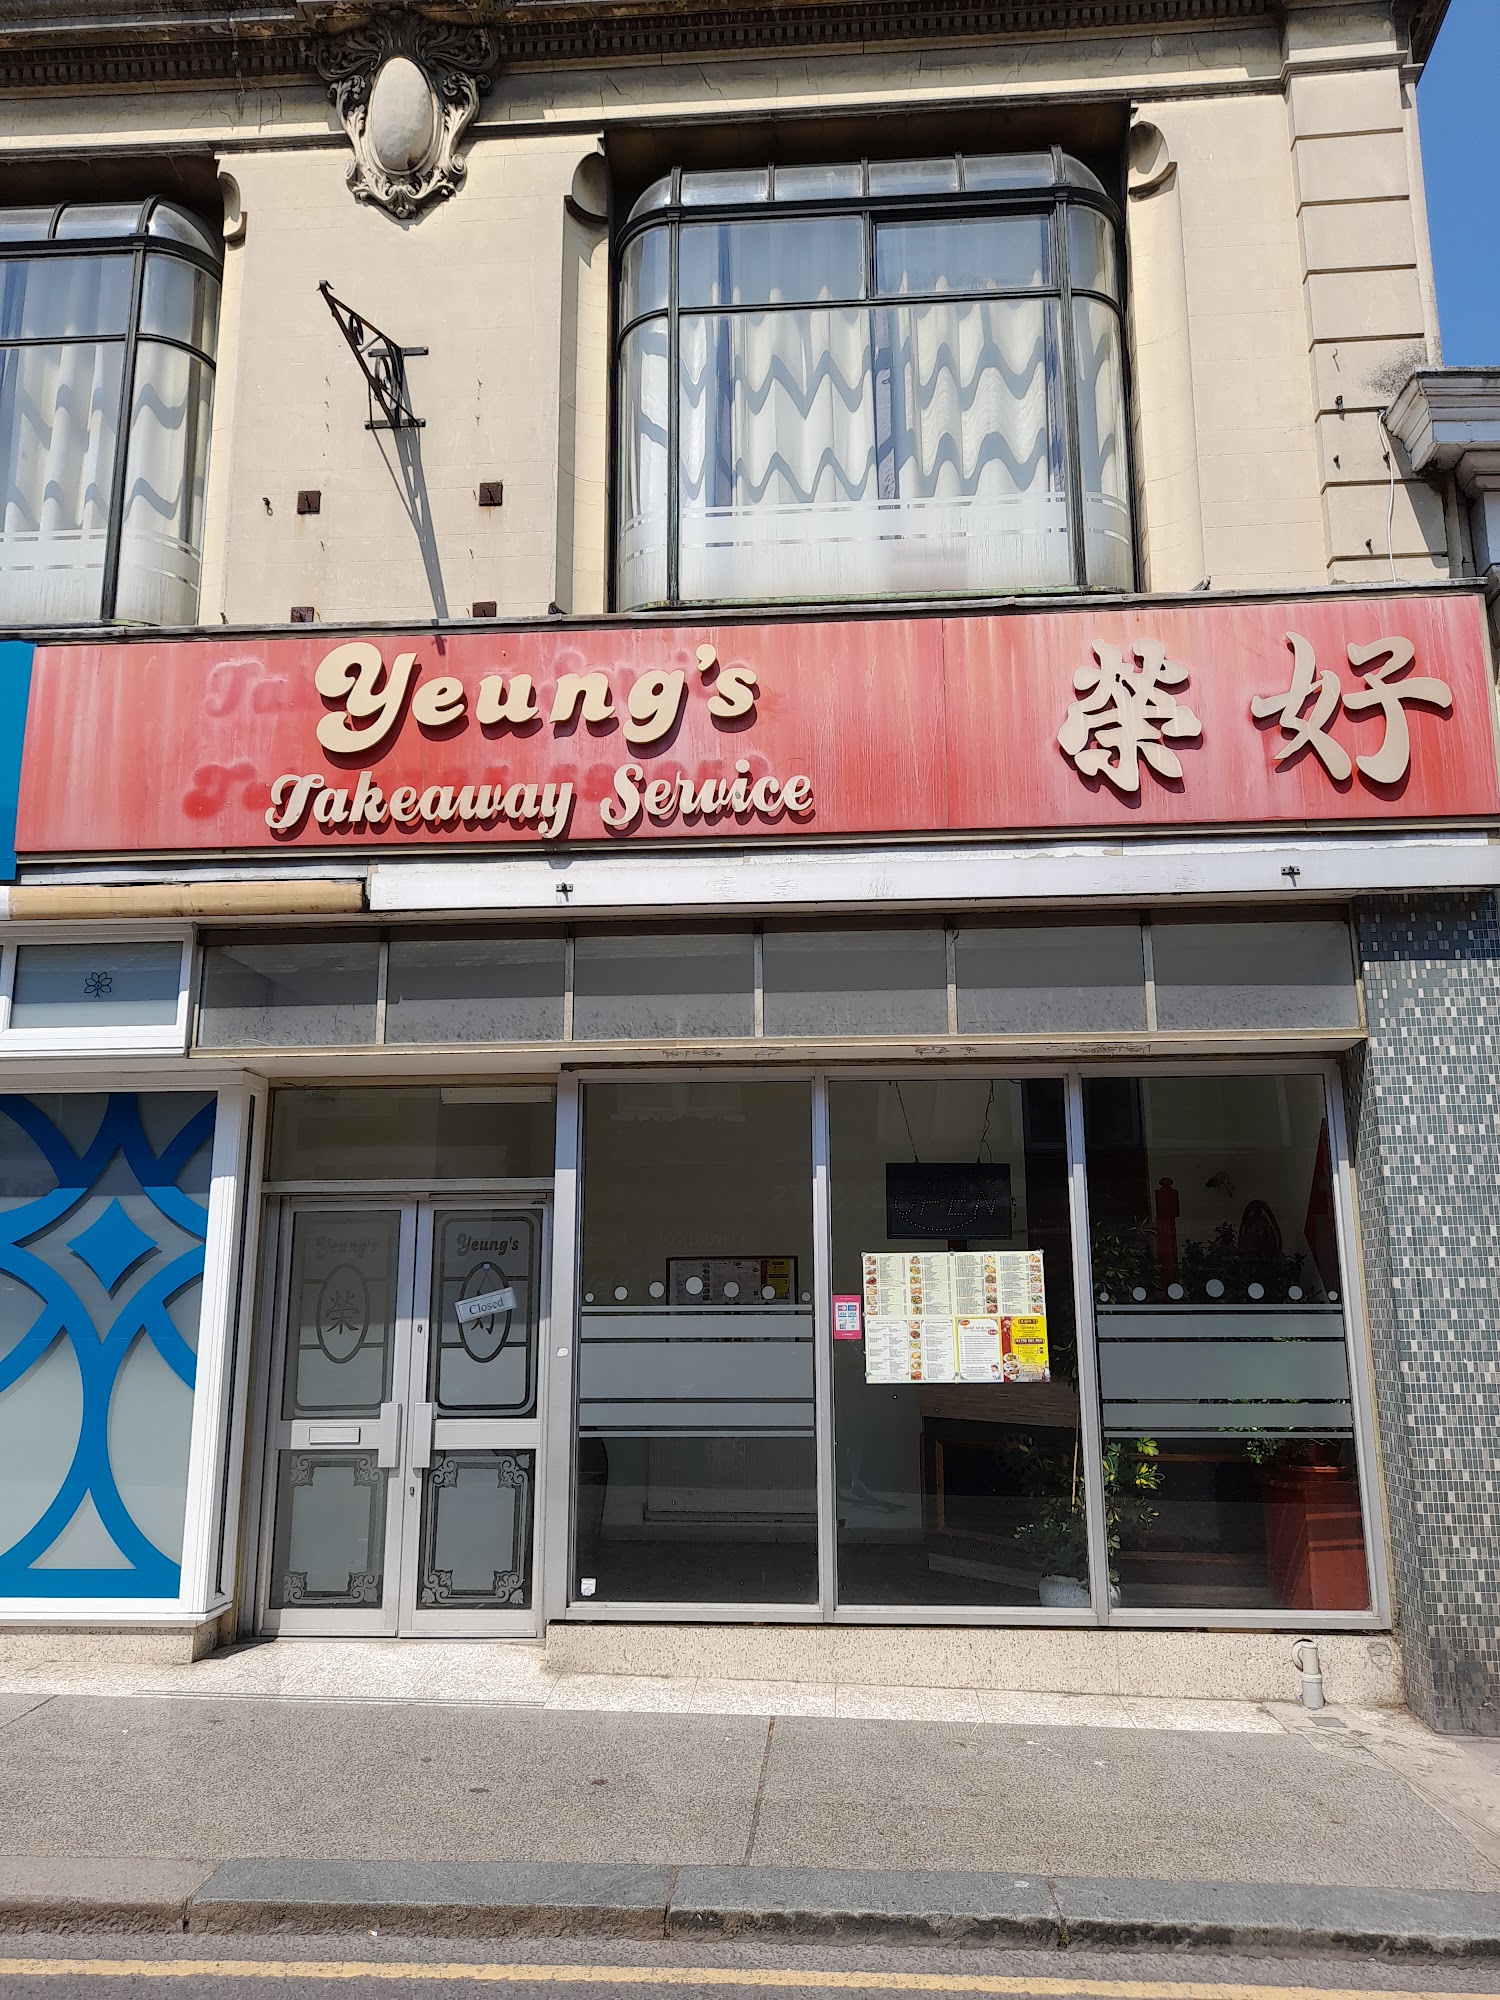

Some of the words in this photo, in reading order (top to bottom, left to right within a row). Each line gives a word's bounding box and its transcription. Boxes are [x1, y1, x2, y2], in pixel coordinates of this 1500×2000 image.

[314, 641, 758, 753] Yeung's
[264, 770, 574, 839] Takeaway
[600, 759, 813, 828] Service
[894, 1184, 1000, 1217] OPEN
[456, 1232, 520, 1257] Yeung's
[469, 1296, 505, 1315] Closed
